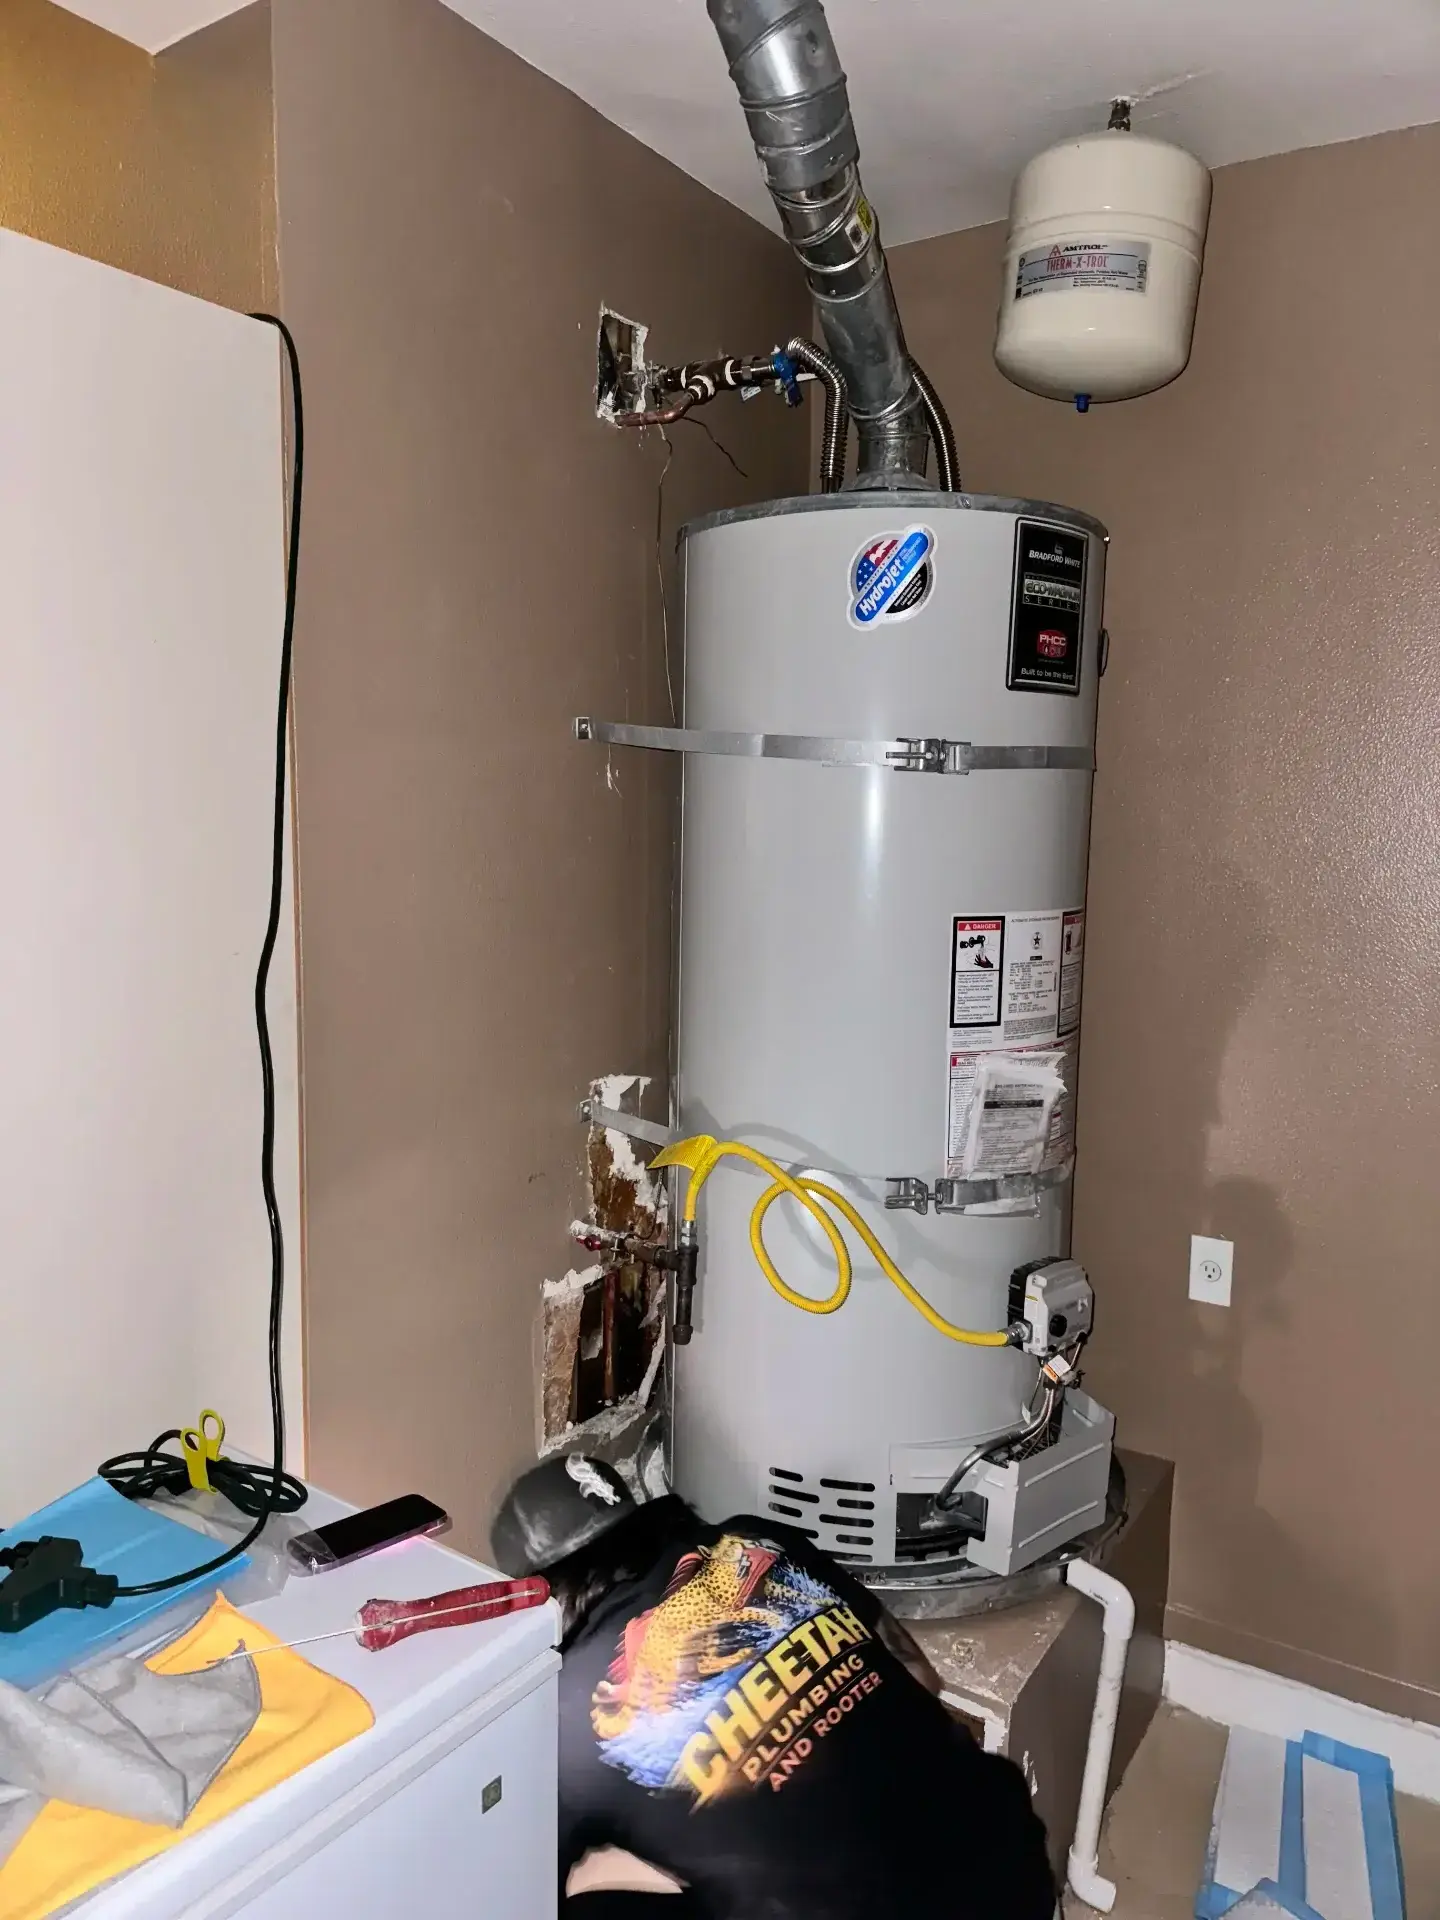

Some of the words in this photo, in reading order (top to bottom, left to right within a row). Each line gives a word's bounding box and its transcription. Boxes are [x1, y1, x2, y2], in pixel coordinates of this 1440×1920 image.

[1063, 244, 1103, 252] AMTROL
[1047, 255, 1107, 272] THERM-X-TROL
[1029, 549, 1064, 563] BRADFORD
[1064, 556, 1080, 568] WHITE
[859, 558, 904, 616] Hydrojet
[1025, 595, 1079, 610] SERIES
[1039, 634, 1066, 646] PHCC
[684, 1606, 873, 1797] CHEETAH
[742, 1653, 865, 1782] PLUMBING
[770, 1737, 813, 1792] AND
[812, 1671, 883, 1737] ROOTER
